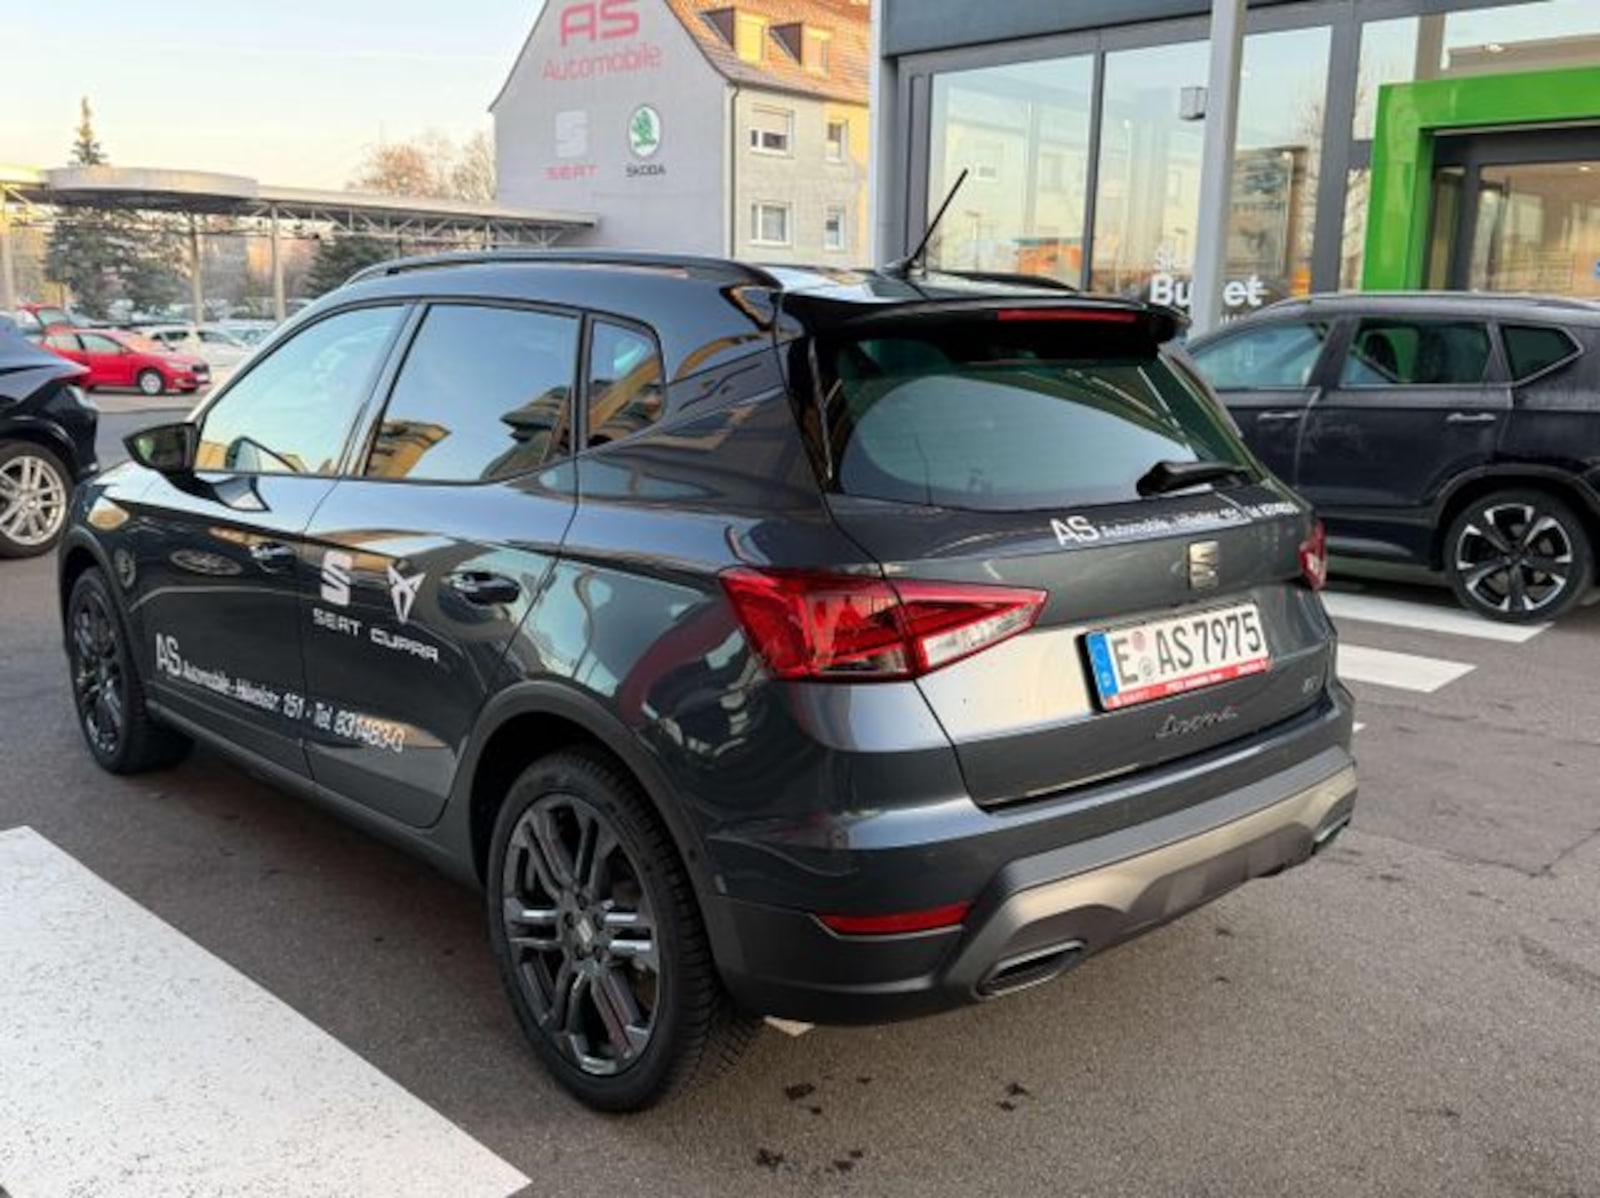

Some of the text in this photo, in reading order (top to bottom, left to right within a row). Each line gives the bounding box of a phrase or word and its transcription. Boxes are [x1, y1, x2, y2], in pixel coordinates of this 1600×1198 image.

[559, 0, 639, 48] AS
[543, 41, 662, 81] Automobile
[1150, 272, 1262, 307] Buet
[1050, 516, 1100, 546] AS
[156, 632, 180, 677] AS
[312, 607, 439, 663] SEAT CUPRA
[1112, 638, 1138, 685] E
